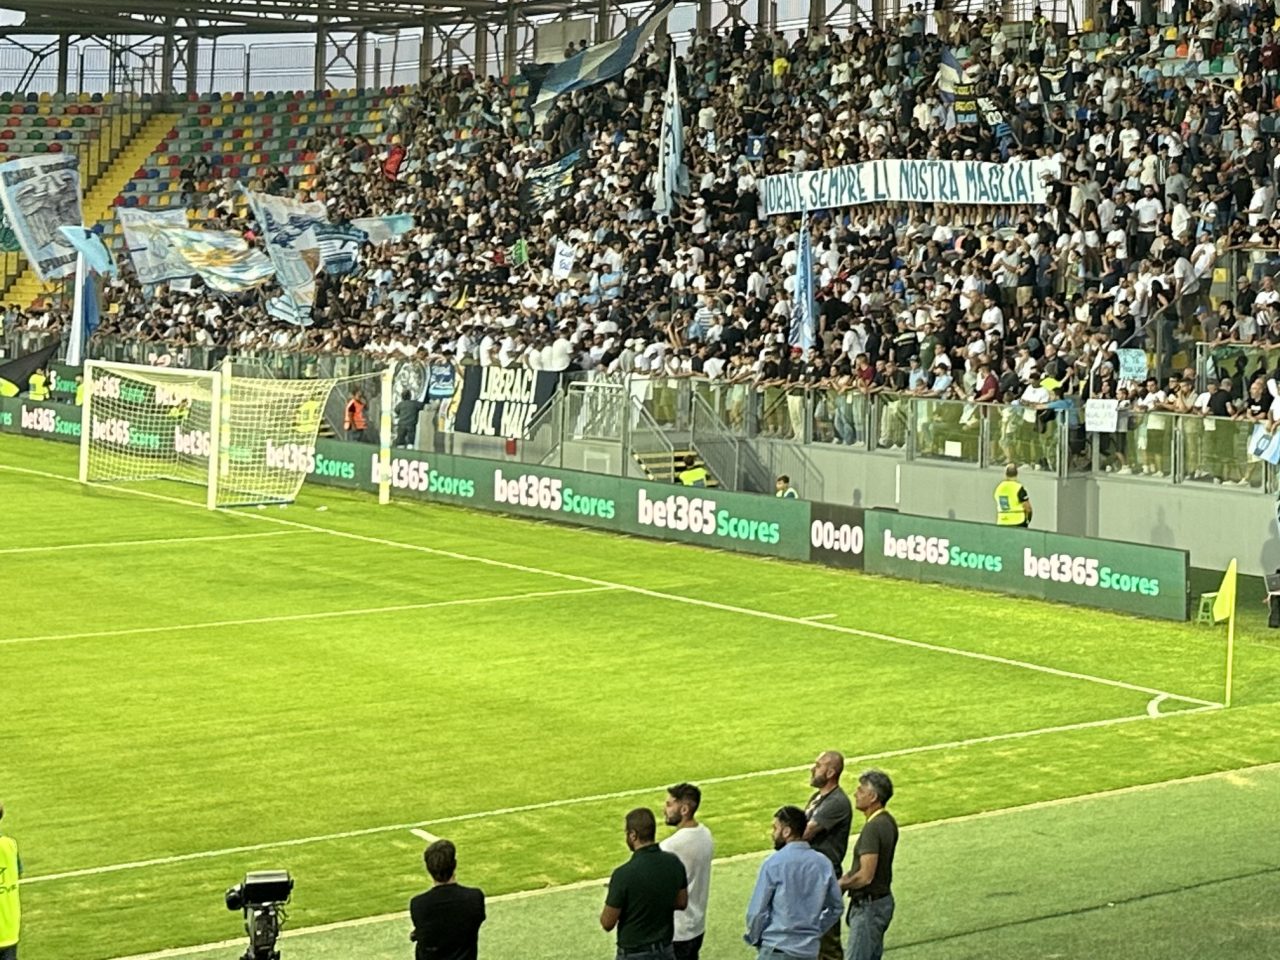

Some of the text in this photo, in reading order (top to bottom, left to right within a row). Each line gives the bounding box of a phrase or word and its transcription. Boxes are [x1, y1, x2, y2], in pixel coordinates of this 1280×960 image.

[809, 164, 867, 207] SEMPRE
[899, 160, 960, 200] NOSTRA
[965, 161, 1036, 203] MAGLIA!
[479, 366, 538, 403] LIBERACI
[175, 424, 211, 456] bet36
[470, 399, 538, 441] DAL MALE
[315, 453, 355, 480] Scores
[371, 453, 475, 498] bt365 Scores
[494, 469, 615, 519] bet365 Scores
[638, 489, 780, 544] bet365 Scores
[811, 519, 864, 554] 00:00
[884, 529, 1003, 572] bet365 Scores
[1023, 547, 1160, 596] bet365 Scores
